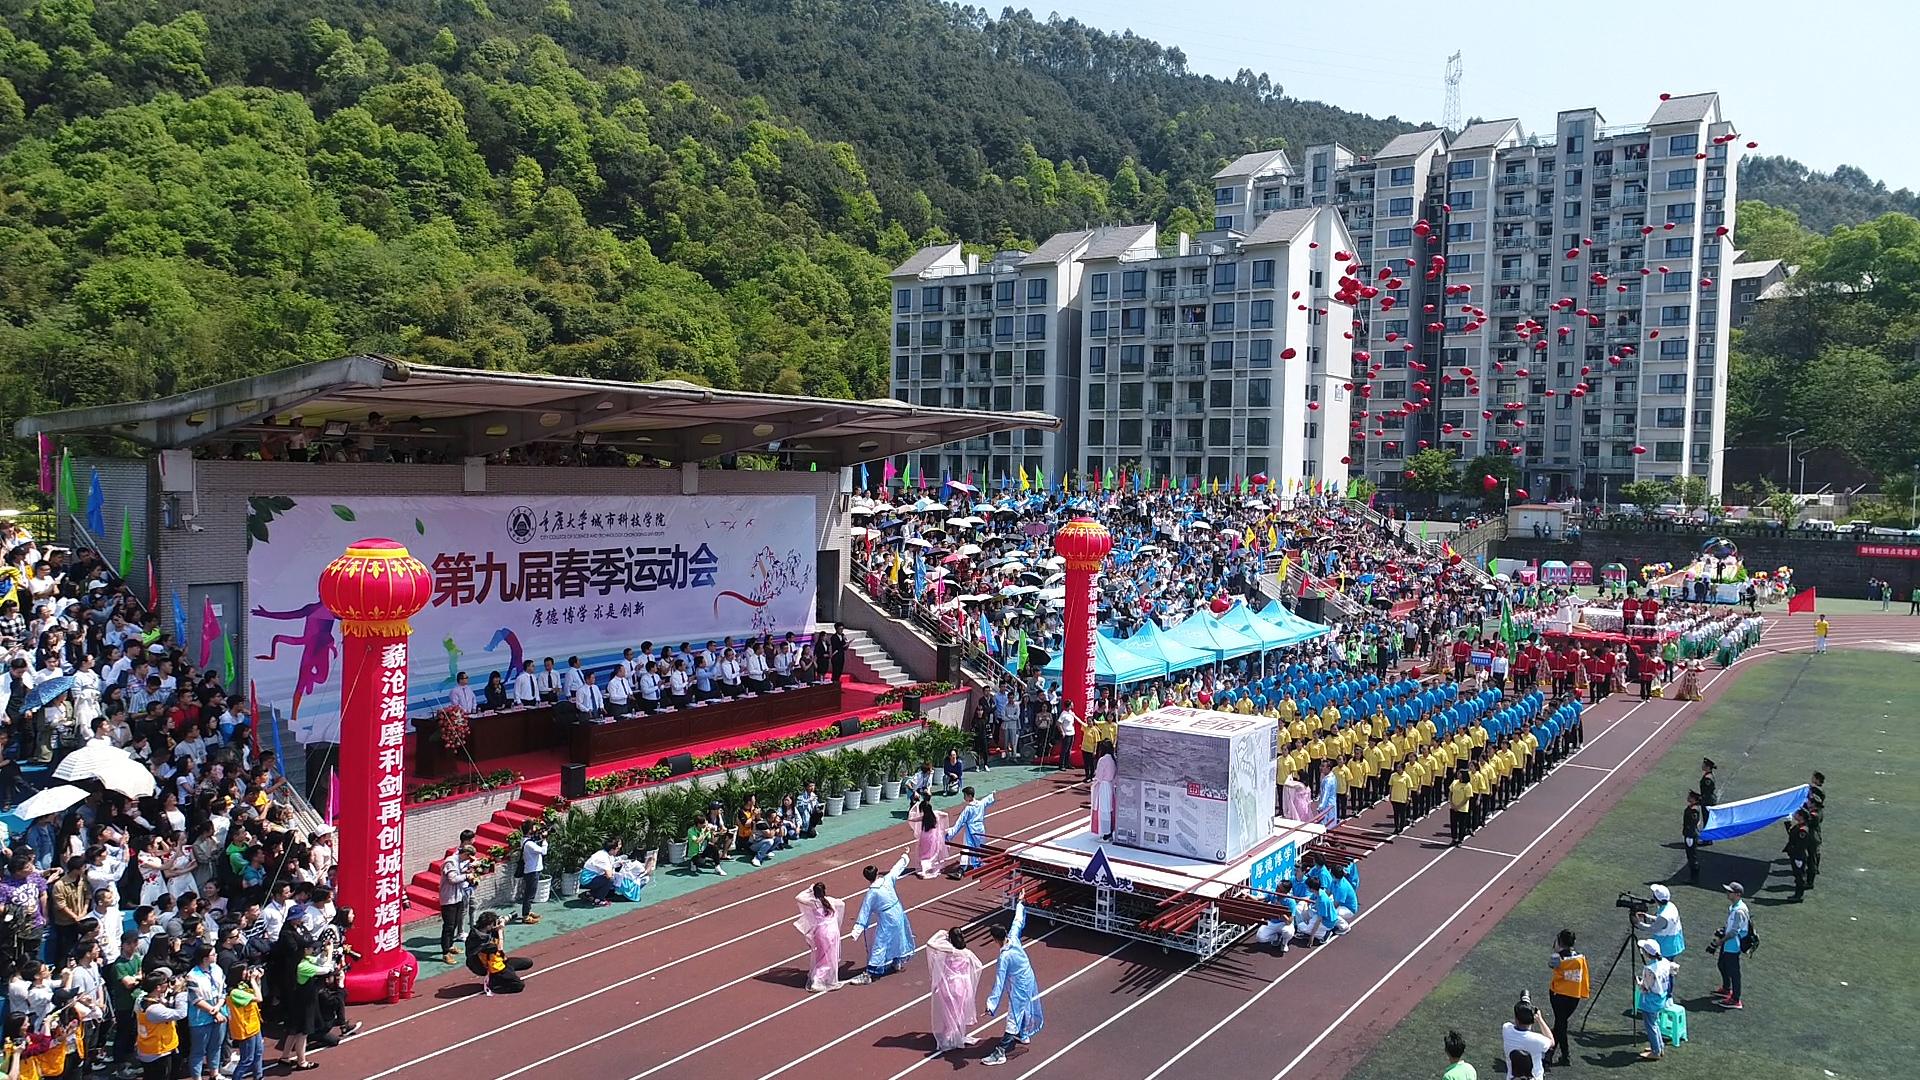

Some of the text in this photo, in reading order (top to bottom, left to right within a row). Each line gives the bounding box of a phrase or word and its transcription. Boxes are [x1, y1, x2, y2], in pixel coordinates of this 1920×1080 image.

[539, 510, 666, 533] 重庆大学城市科技学院
[431, 542, 719, 608] 第九届春季运动会
[372, 642, 408, 955] 藐沧海磨利剑再创城科辉煌
[1255, 846, 1292, 880] 厚德博学
